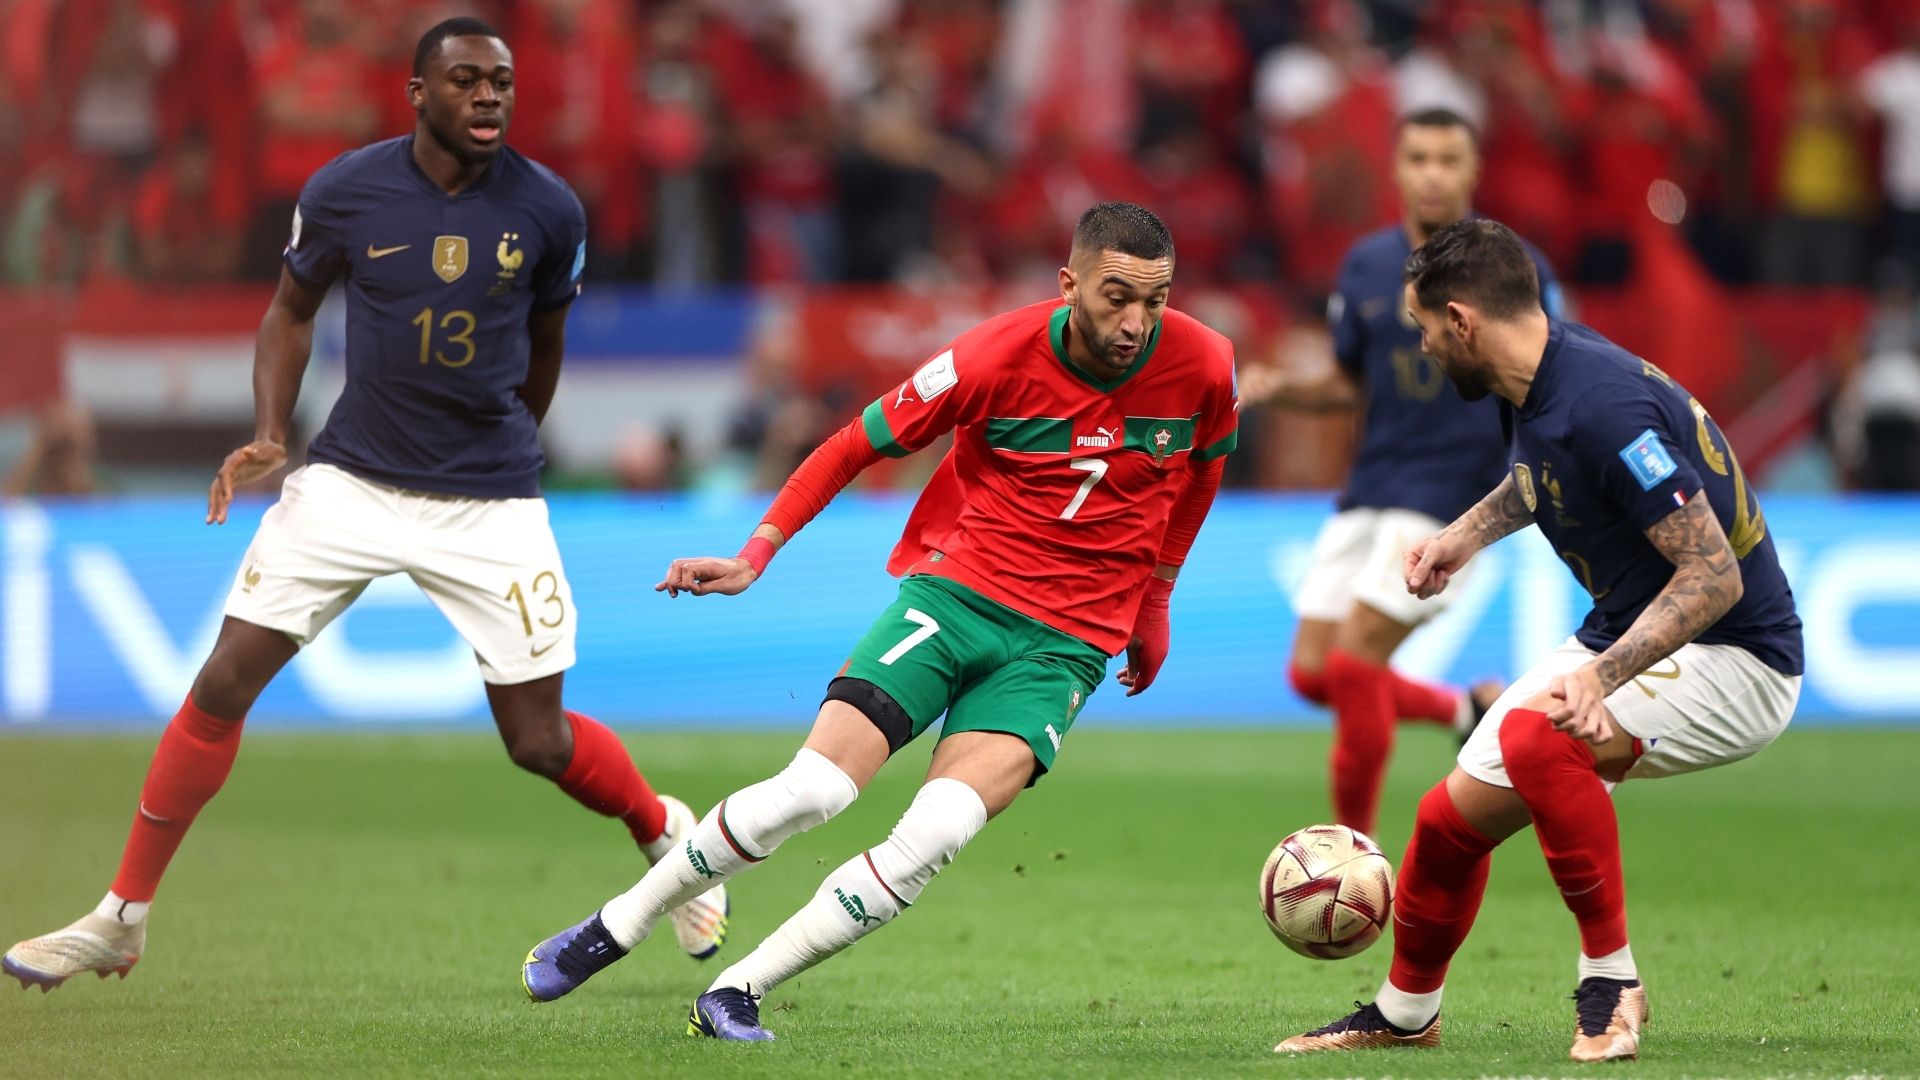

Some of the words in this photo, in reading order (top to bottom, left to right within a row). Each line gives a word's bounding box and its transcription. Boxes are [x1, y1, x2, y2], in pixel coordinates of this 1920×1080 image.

[412, 306, 477, 368] 13
[1076, 436, 1109, 447] PUMA
[1058, 457, 1109, 519] 7
[504, 570, 564, 637] 13
[878, 607, 941, 666] 7
[686, 839, 706, 875] PUMA
[834, 887, 862, 922] PUMA
